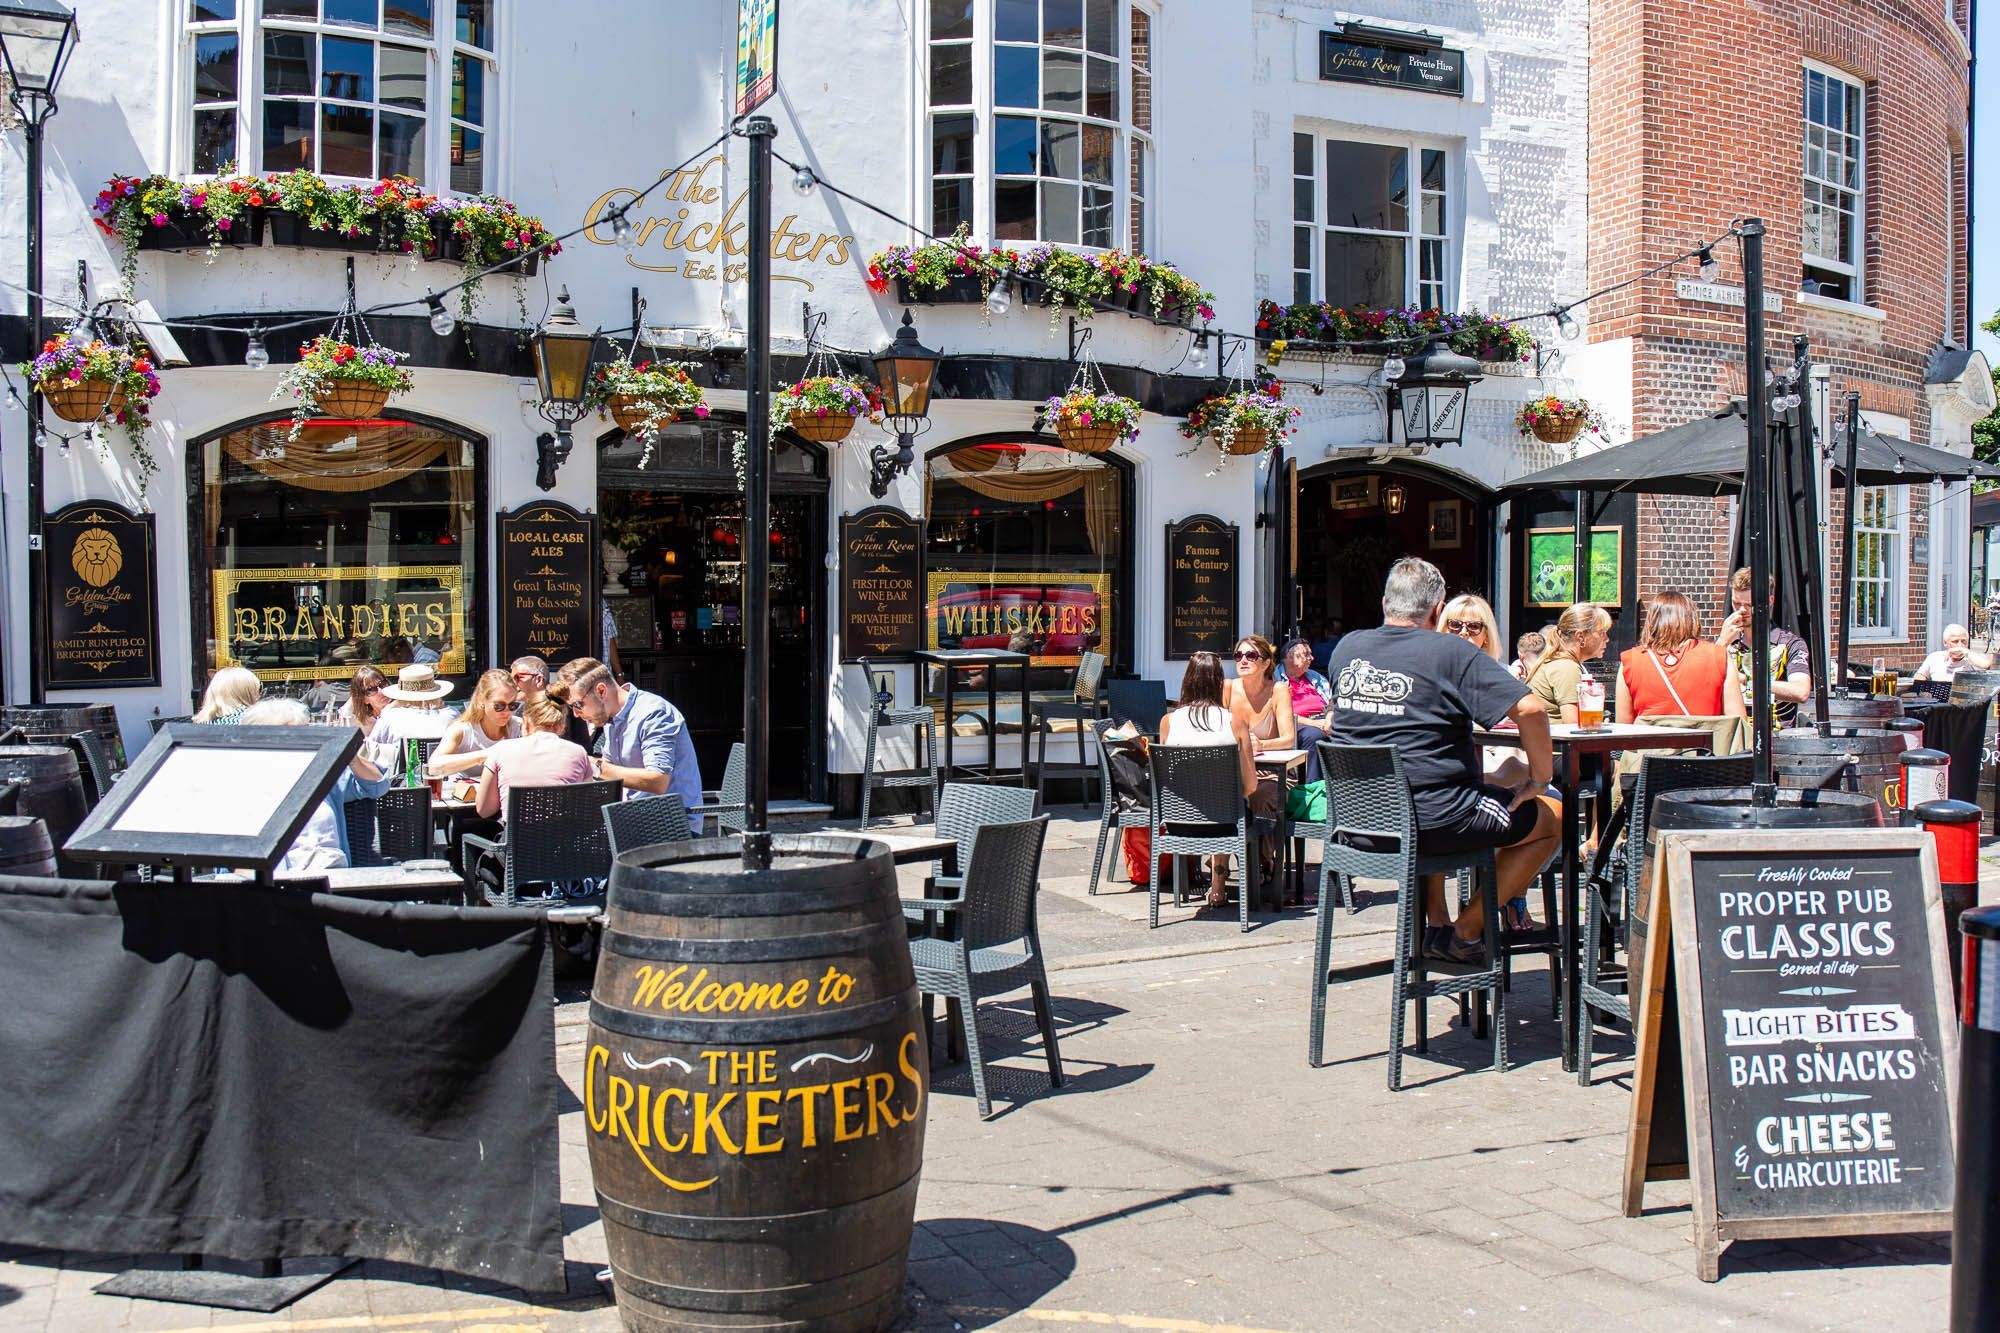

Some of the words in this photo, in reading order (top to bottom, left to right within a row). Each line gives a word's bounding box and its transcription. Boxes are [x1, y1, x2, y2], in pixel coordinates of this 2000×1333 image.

[1332, 53, 1369, 71] Greene
[1371, 57, 1402, 74] Room
[1408, 55, 1436, 70] Private
[1436, 60, 1454, 72] Hire
[1419, 69, 1444, 82] Venue
[660, 155, 727, 205] The
[582, 187, 855, 266] Crickters
[683, 259, 718, 281] Est.
[1681, 284, 1713, 299] PRINCE
[1715, 289, 1746, 303] ALBER
[1407, 389, 1425, 433] CRICKETERS
[1431, 390, 1463, 433] CRICKETERS
[30, 537, 39, 548] 4
[509, 532, 550, 543] LOCAL
[552, 532, 585, 543] CASK
[850, 538, 883, 554] Greene
[886, 539, 915, 553] Room
[530, 546, 564, 557] ALES
[1185, 545, 1220, 556] Famous
[1193, 559, 1229, 571] Century
[852, 579, 878, 589] FIRST
[879, 579, 913, 589] FLOOR
[1194, 573, 1210, 583] Inn
[65, 588, 106, 608] Golden
[106, 585, 132, 602] Lion
[513, 579, 540, 592] Great
[544, 579, 582, 597] Tasting
[858, 591, 885, 601] WINE
[886, 591, 908, 601] BAR
[516, 596, 534, 609] Pub
[537, 596, 580, 609] Classics
[877, 602, 888, 612] &
[233, 601, 447, 642] BRANDIES
[532, 612, 568, 625] Served
[851, 614, 890, 624] PRIVATE
[891, 614, 914, 624] HIRE
[943, 604, 1097, 636] WHISKIES
[527, 630, 544, 642] All
[547, 630, 569, 645] Day
[866, 625, 900, 635] VENUE
[53, 638, 88, 649] FAMILY
[88, 638, 109, 648] RUN
[110, 637, 129, 648] PUB
[56, 649, 105, 660] BRIGHTON
[106, 650, 116, 659] &
[117, 648, 144, 658] HOVE
[1757, 866, 1808, 886] Freshly
[1808, 866, 1855, 882] Cooked
[1719, 890, 1828, 917] PROPER
[1836, 888, 1893, 914] PUB
[1720, 921, 1896, 960] CLASSICS
[1779, 962, 1822, 977] Served
[1822, 961, 1837, 975] all
[1838, 961, 1860, 977] day
[631, 964, 808, 1013] Welcome
[817, 965, 857, 1005] to
[1734, 1013, 1807, 1038] LIGHT
[1815, 1011, 1899, 1034] BITES
[699, 1049, 778, 1086] THE
[1728, 1054, 1787, 1087] BAR
[1796, 1049, 1917, 1084] SNACKS
[585, 1030, 923, 1192] CRICKETERS
[1755, 1111, 1897, 1157] CHEESE
[1734, 1144, 1751, 1174] &
[1753, 1158, 1903, 1190] CHARCUTERIE
